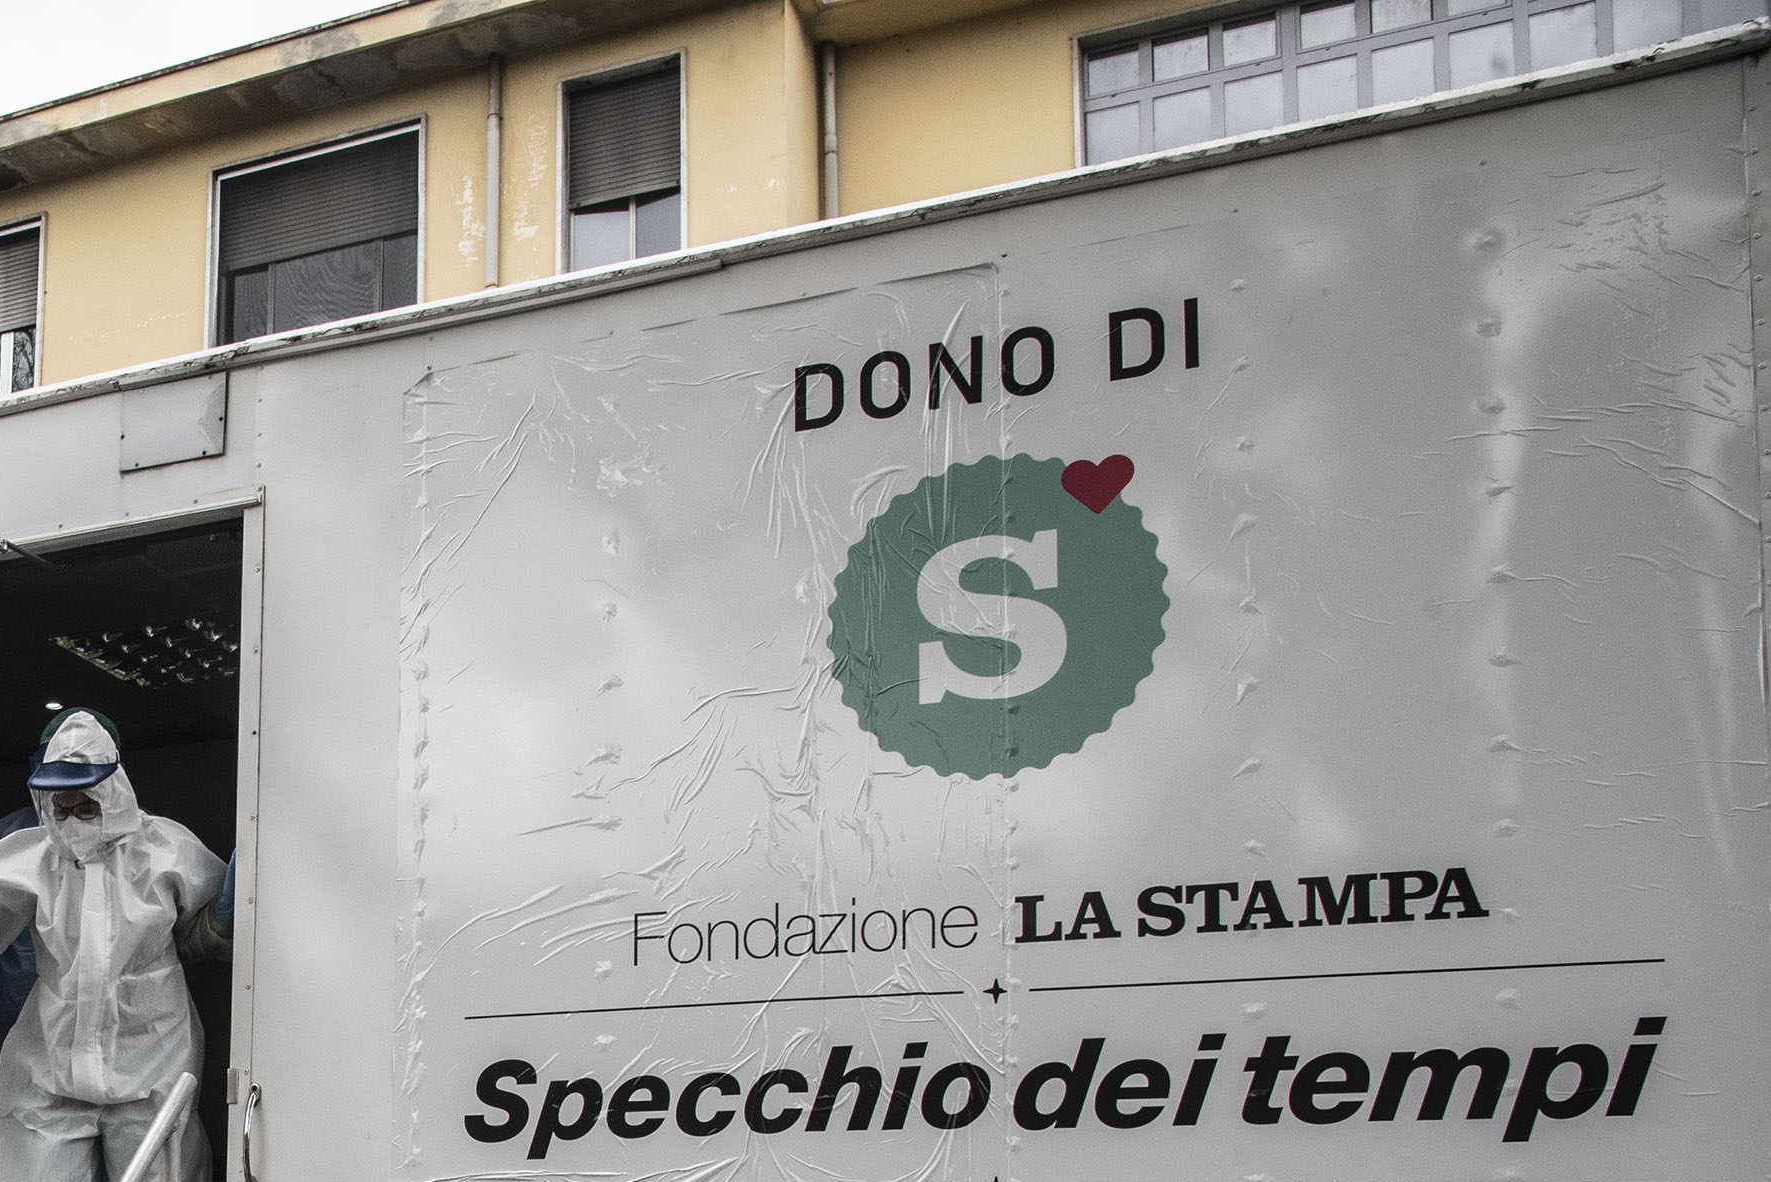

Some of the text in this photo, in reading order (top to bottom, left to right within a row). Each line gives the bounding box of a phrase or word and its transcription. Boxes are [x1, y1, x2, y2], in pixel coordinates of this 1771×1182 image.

[794, 297, 1201, 433] DONO DI
[916, 528, 1069, 705] S
[633, 867, 1490, 967] Fondazione LA STAMPA
[463, 1016, 1668, 1160] Specchio dei tempi
